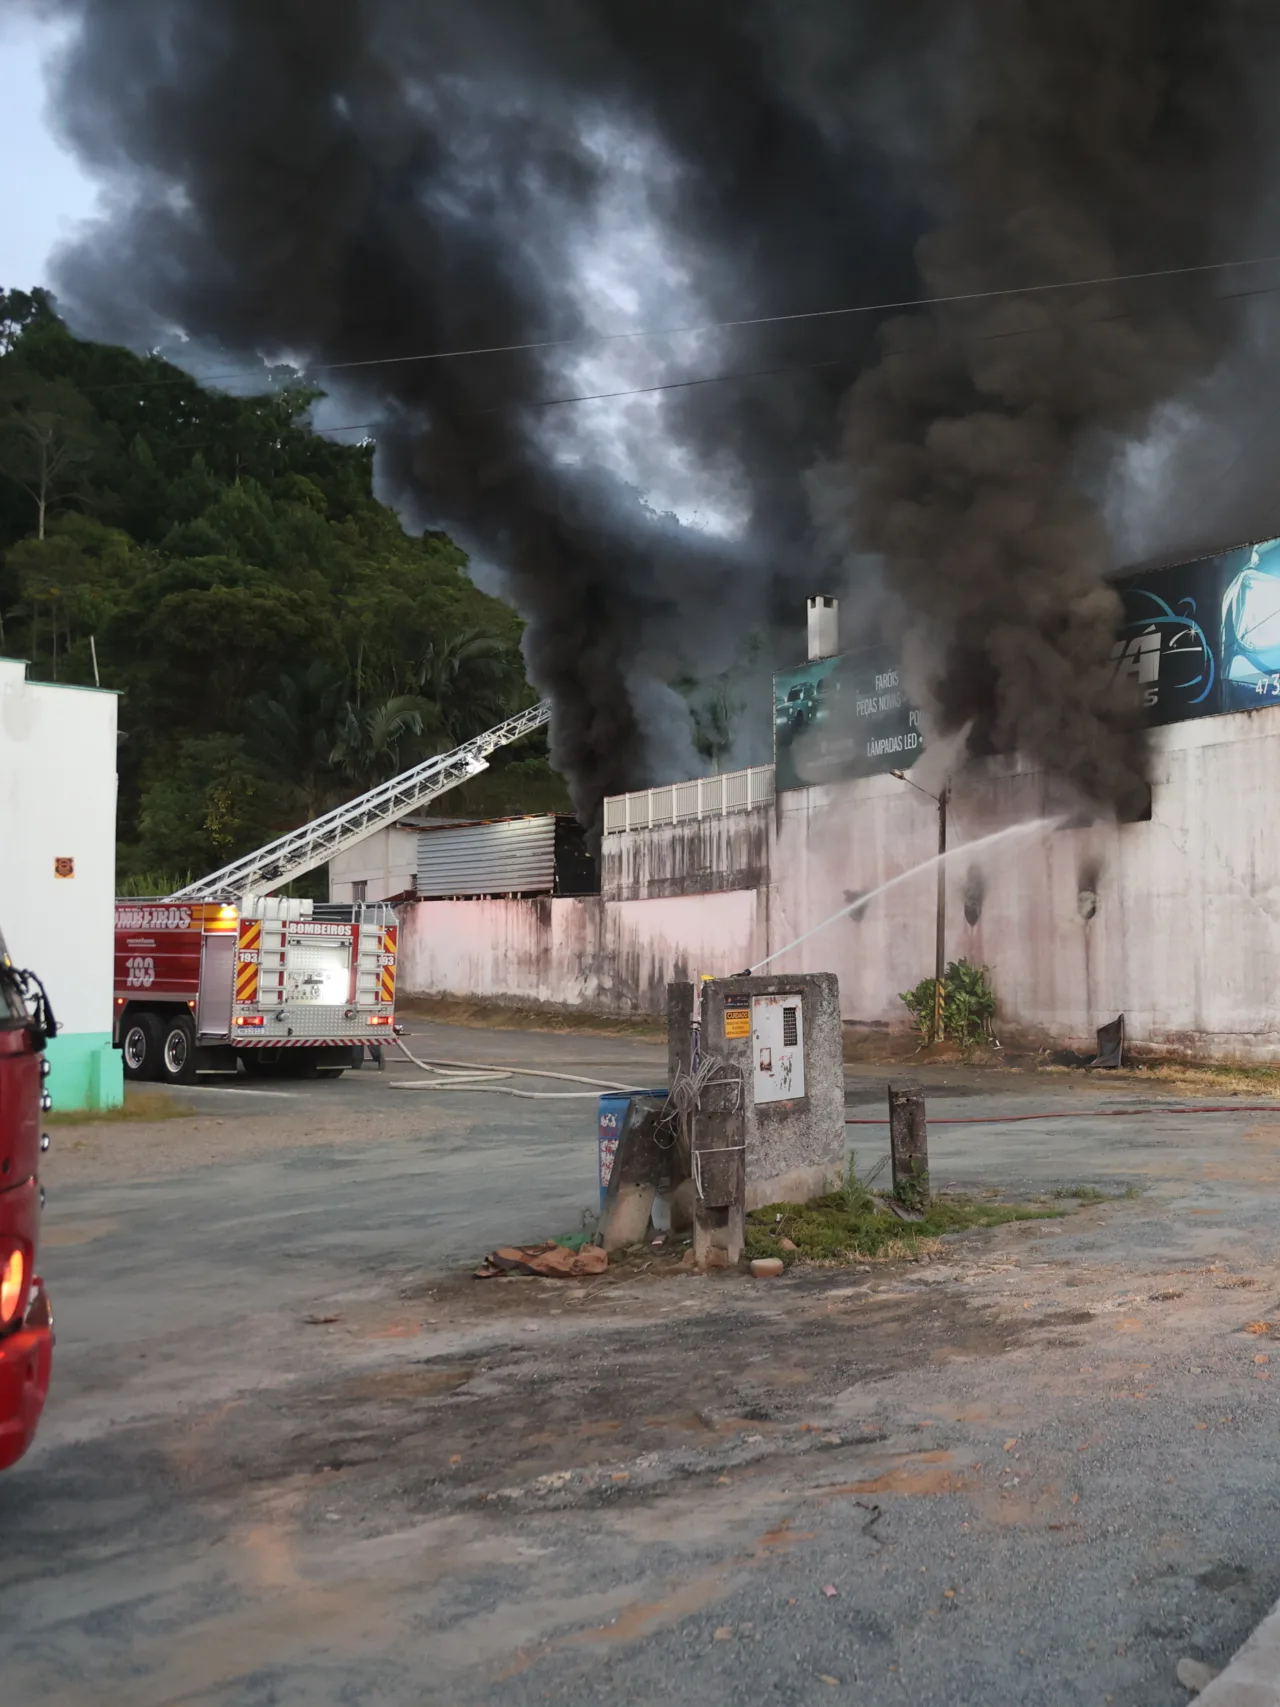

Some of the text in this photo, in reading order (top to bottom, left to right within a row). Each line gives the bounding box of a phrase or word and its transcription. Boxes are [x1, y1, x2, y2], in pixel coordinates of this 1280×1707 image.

[1256, 680, 1269, 695] 47
[856, 692, 902, 718] PEÇAS NOVAS
[867, 734, 903, 757] LÂMPADAS
[904, 733, 918, 750] LED
[289, 923, 351, 936] BOMBEIROS
[239, 953, 258, 963] 193
